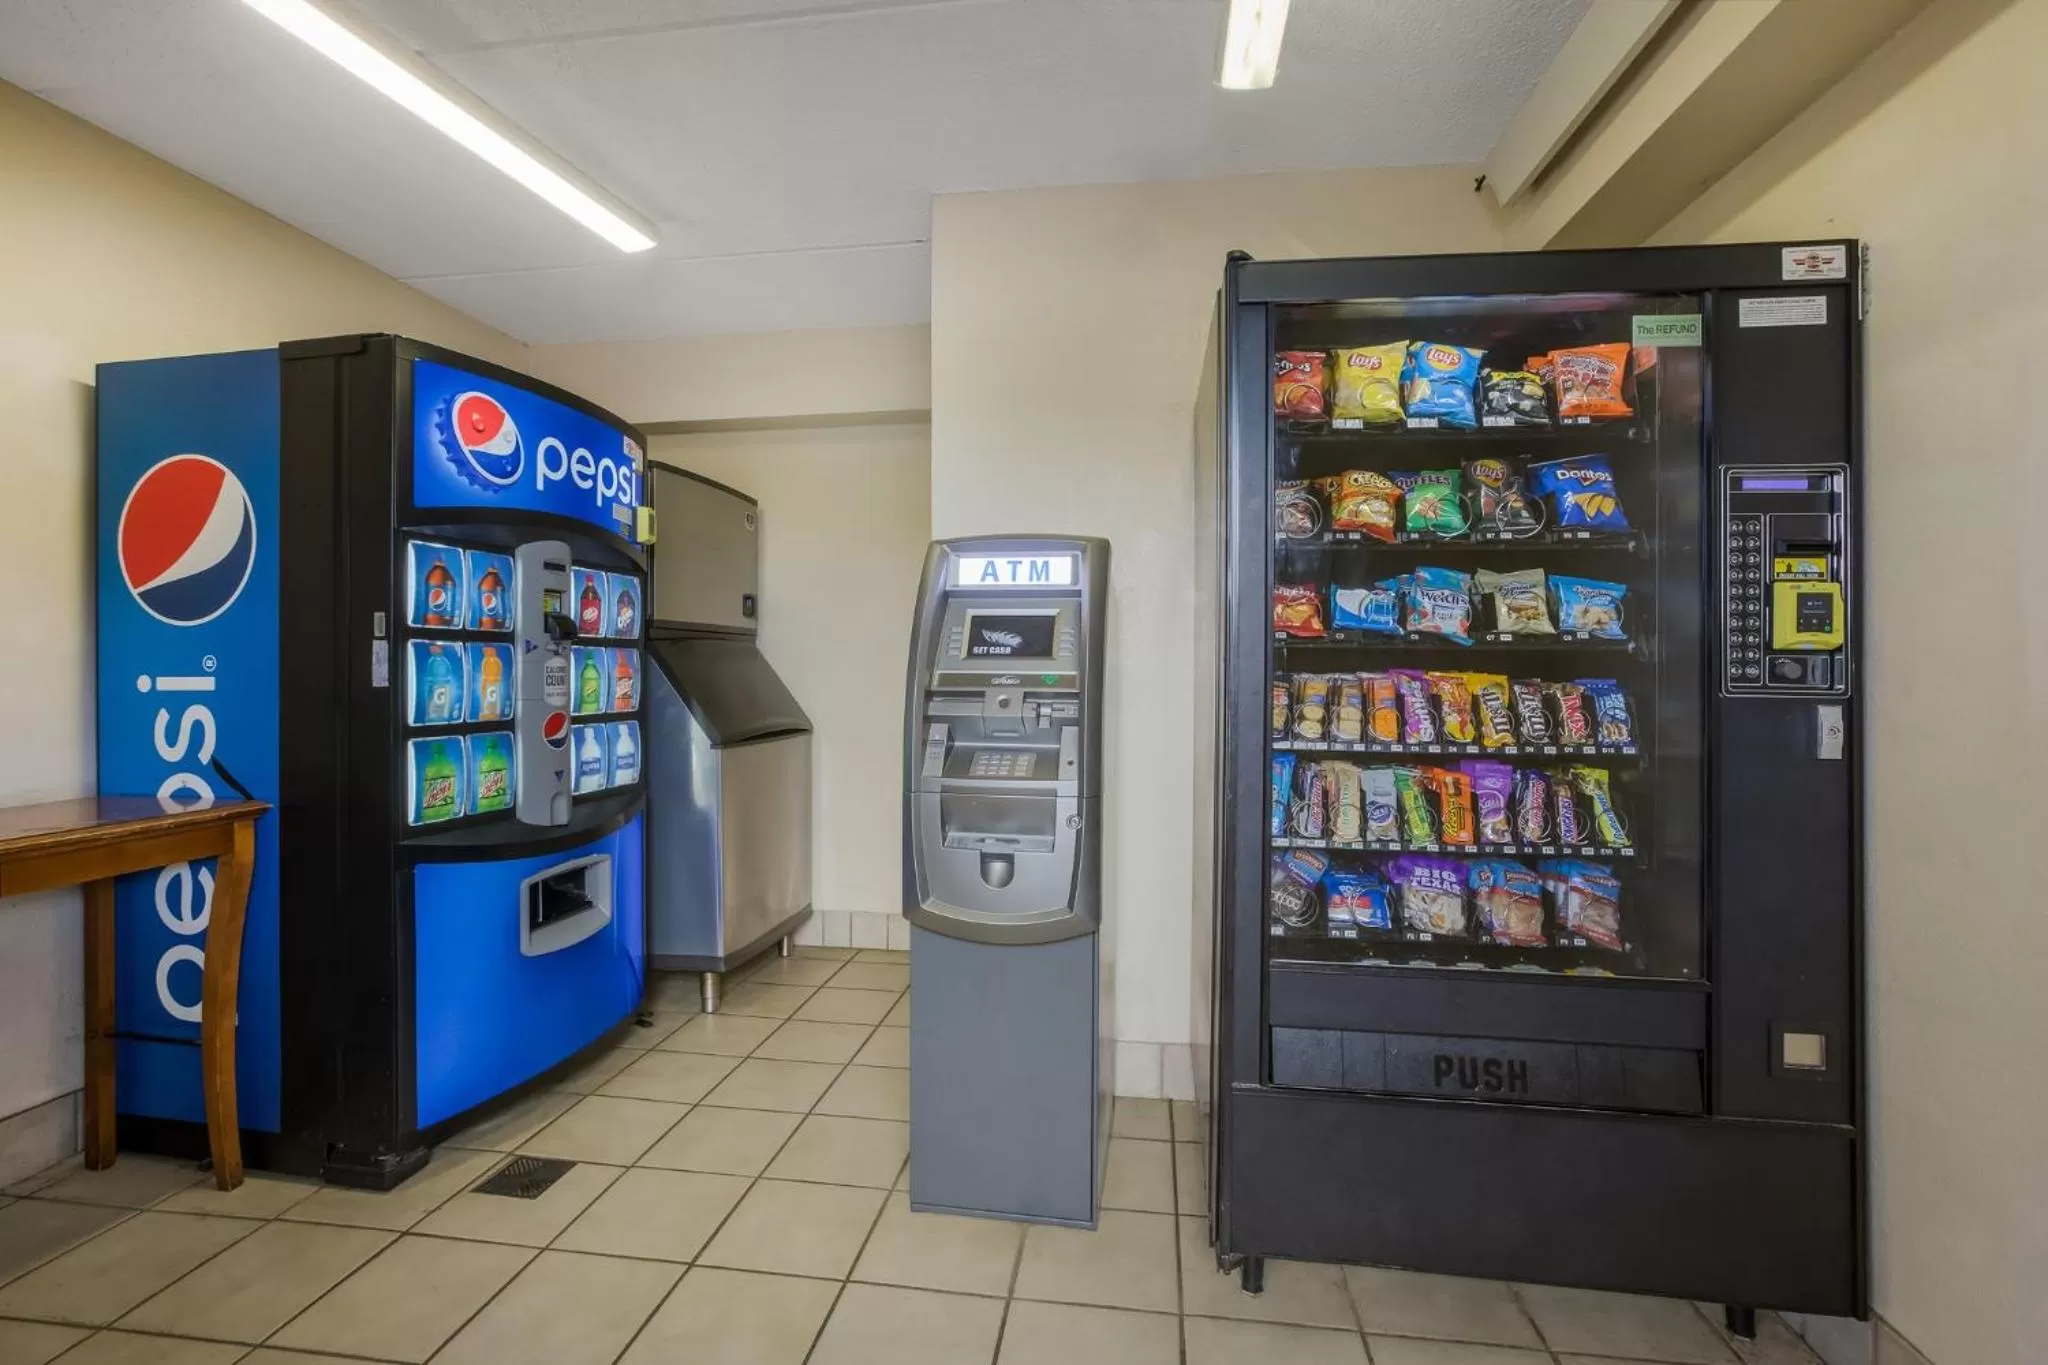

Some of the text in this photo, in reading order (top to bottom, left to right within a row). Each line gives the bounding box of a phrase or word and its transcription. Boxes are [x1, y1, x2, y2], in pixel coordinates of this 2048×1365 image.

[1636, 323, 1697, 335] The REFUND
[1349, 353, 1381, 370] Lay's
[1427, 348, 1461, 365] Lay's
[536, 436, 638, 508] pepsi
[1556, 469, 1613, 482] Doritos
[980, 560, 1050, 583] ATM
[137, 675, 238, 1026] pesi
[1414, 866, 1457, 882] BIG
[1433, 1054, 1529, 1094] PUSH
